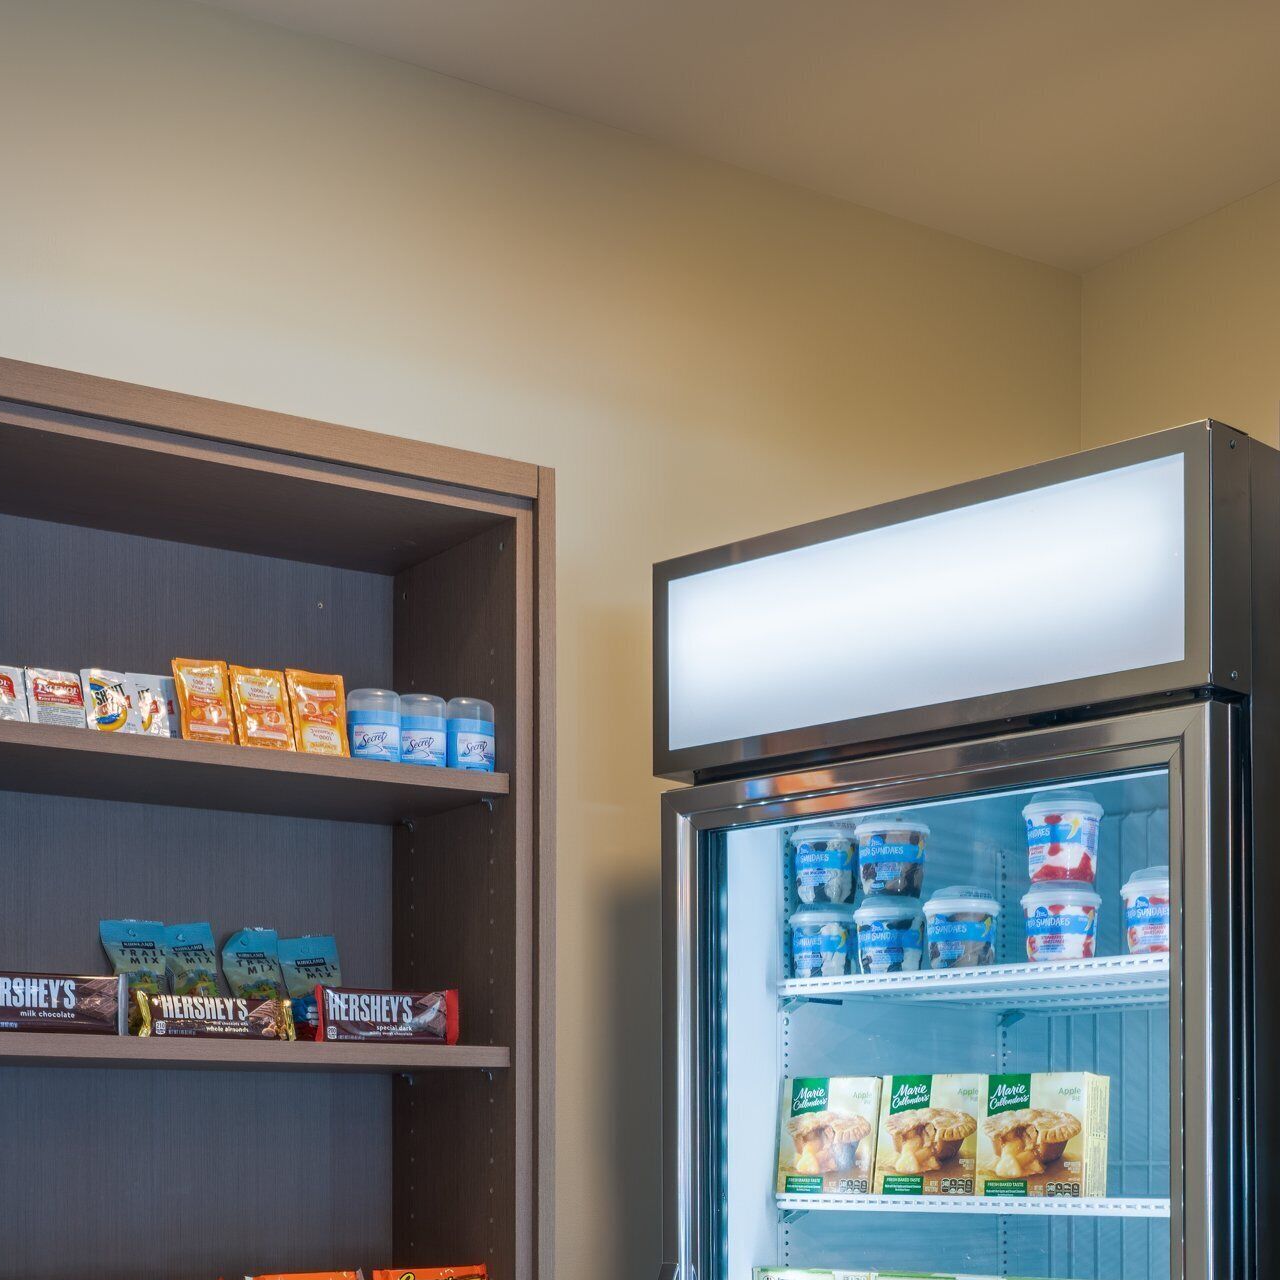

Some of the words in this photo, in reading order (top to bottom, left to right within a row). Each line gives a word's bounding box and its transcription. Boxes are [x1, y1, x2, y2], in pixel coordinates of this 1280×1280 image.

[363, 731, 387, 747] Secret
[410, 737, 434, 752] Secret
[466, 741, 488, 755] Secret
[871, 846, 904, 856] SUNDAES
[1036, 917, 1071, 927] SUNDAES
[130, 956, 159, 965] MIX
[162, 995, 248, 1020] HERSHEY'S
[329, 994, 413, 1023] HERSHEY'S
[794, 1087, 825, 1101] Marie
[896, 1083, 928, 1096] Marie
[990, 1084, 1026, 1098] Marie
[1058, 1087, 1081, 1096] Apple
